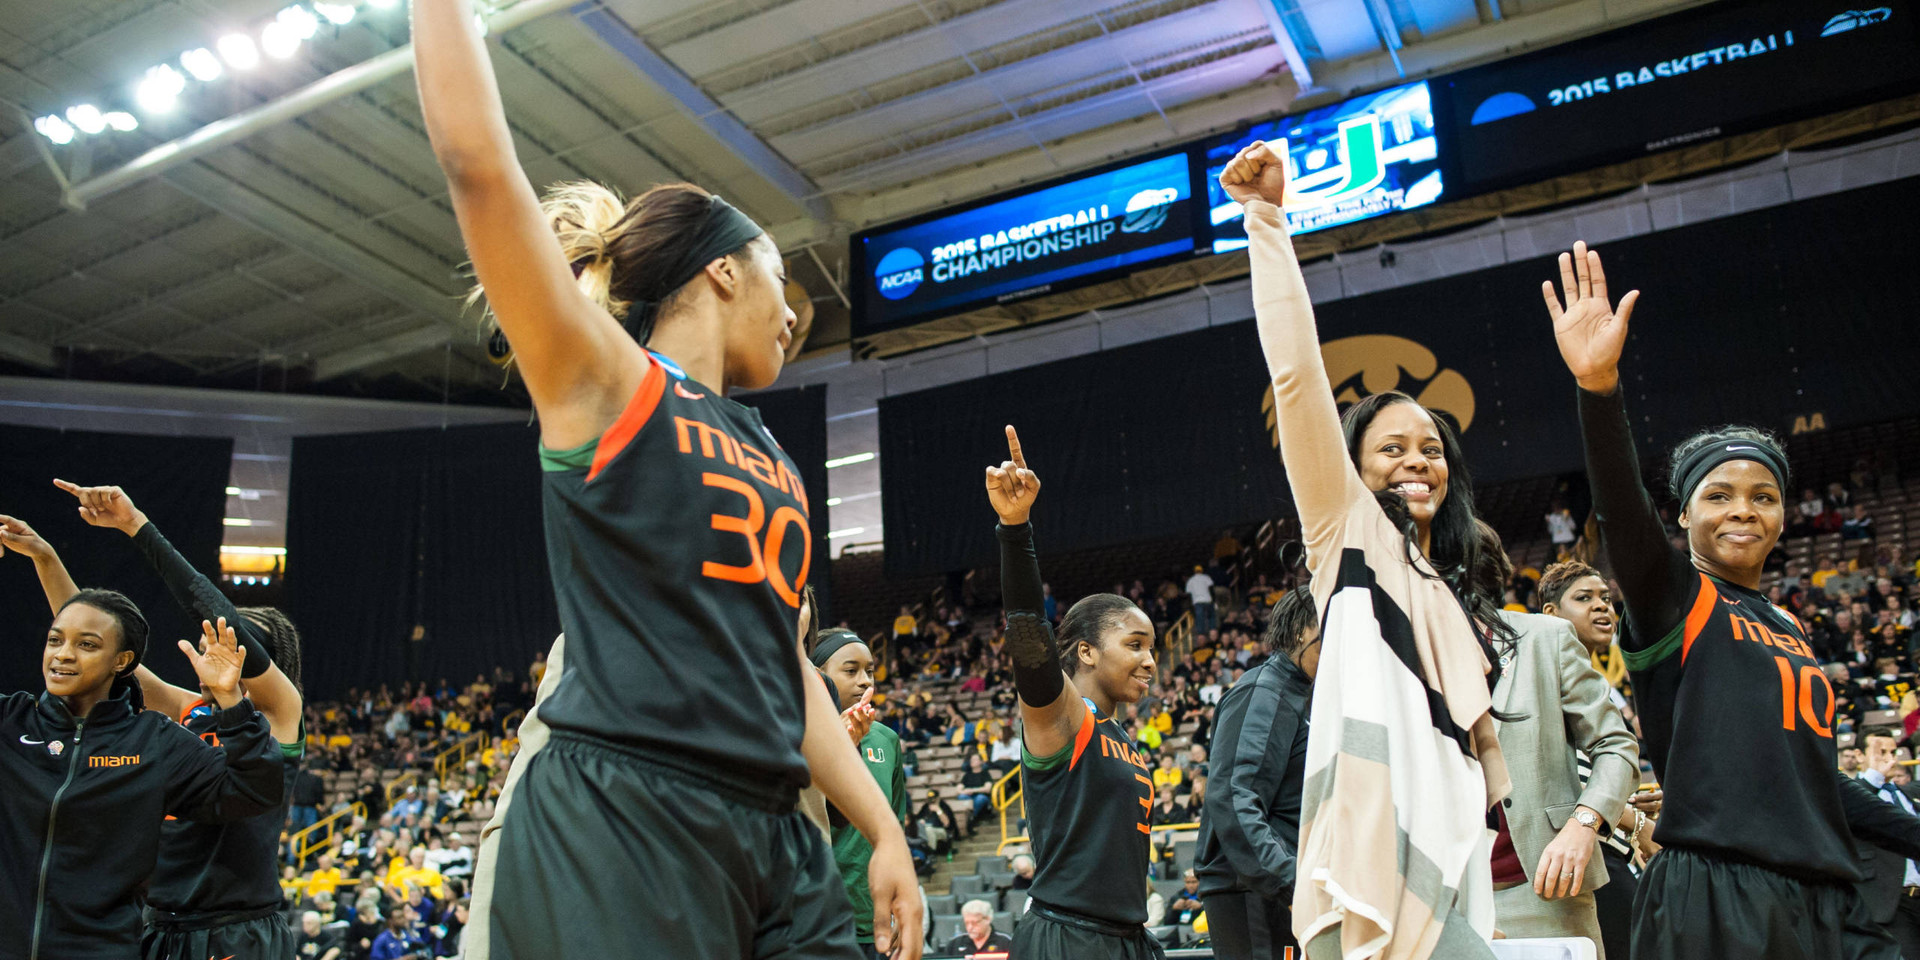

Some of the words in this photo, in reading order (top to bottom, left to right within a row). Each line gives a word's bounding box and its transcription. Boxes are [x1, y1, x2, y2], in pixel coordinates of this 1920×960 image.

[1547, 76, 1611, 107] 2015
[881, 268, 924, 290] NCAA
[931, 238, 978, 264] 2015
[932, 221, 1116, 283] CHAMPIONSHIP
[701, 471, 812, 609] 30
[1774, 656, 1836, 738] 10
[1134, 773, 1155, 834] 3
